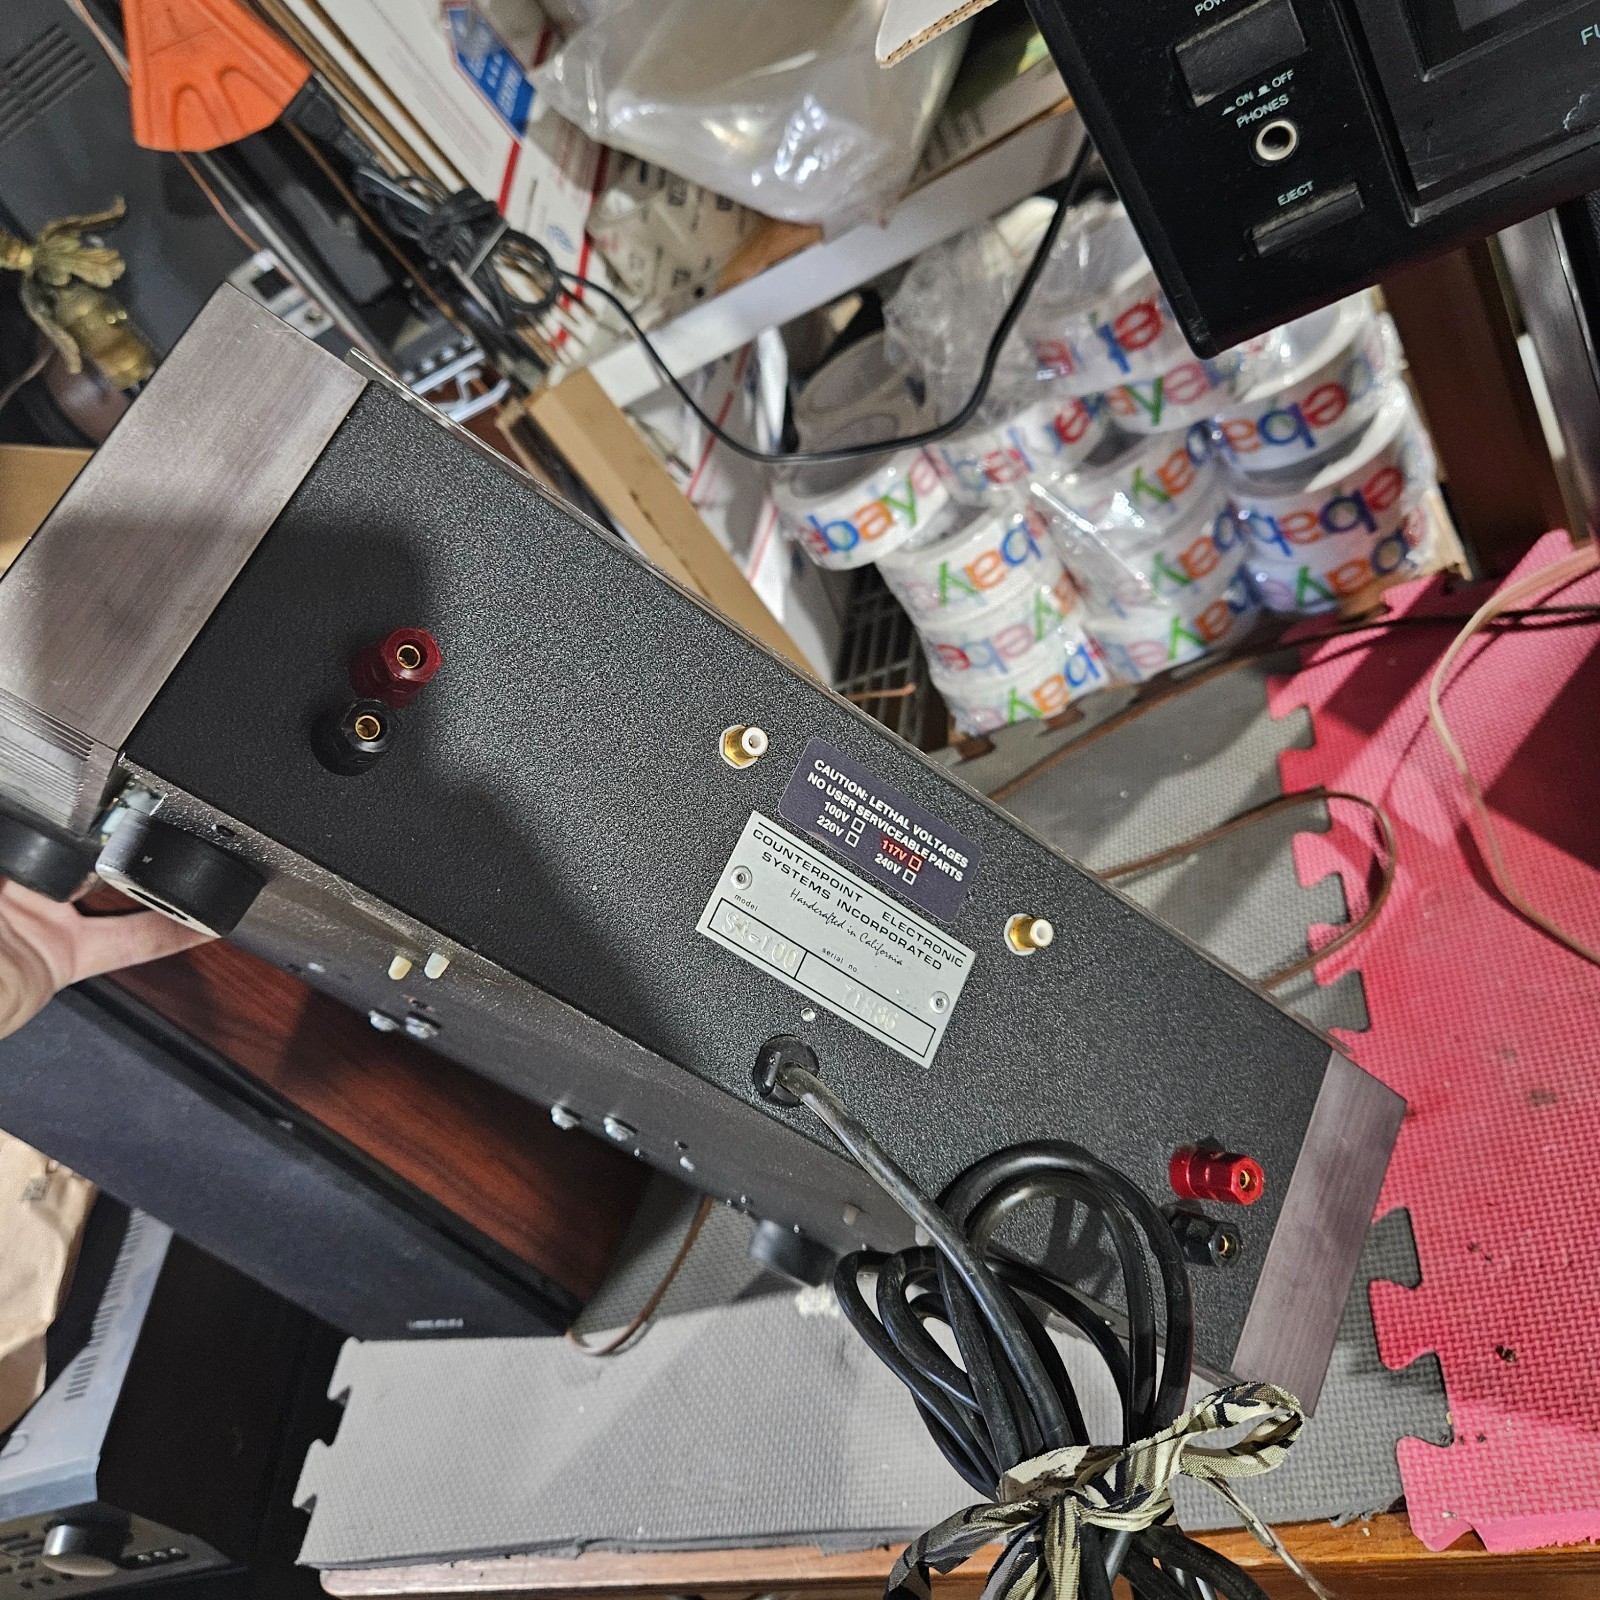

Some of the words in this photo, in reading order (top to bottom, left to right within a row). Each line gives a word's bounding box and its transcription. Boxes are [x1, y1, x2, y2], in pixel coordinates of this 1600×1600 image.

[1235, 91, 1254, 107] ON
[1271, 69, 1294, 88] OFF
[1236, 93, 1290, 128] PHONES
[1277, 180, 1314, 206] EJECT
[807, 772, 826, 790] NO
[826, 785, 857, 812] USER
[855, 804, 928, 860] SERVICEABLE
[927, 853, 964, 882] PARTS
[814, 760, 869, 801] CAUTION:
[868, 796, 910, 830] LETHAL
[913, 824, 970, 868] VOLTAGES
[824, 801, 850, 823] 100V
[881, 840, 908, 861] 117V
[816, 815, 845, 837] 220V
[874, 853, 902, 875] 240V
[734, 894, 759, 912] model
[752, 829, 863, 902] COUNTERPOINT
[882, 911, 964, 968] ELECTRONIC
[762, 851, 831, 900] SYSTEMS
[836, 899, 942, 970] INCORPORATED
[789, 888, 845, 930] Handcrafted
[846, 925, 857, 937] in
[859, 932, 903, 966] California
[822, 947, 844, 964] serial
